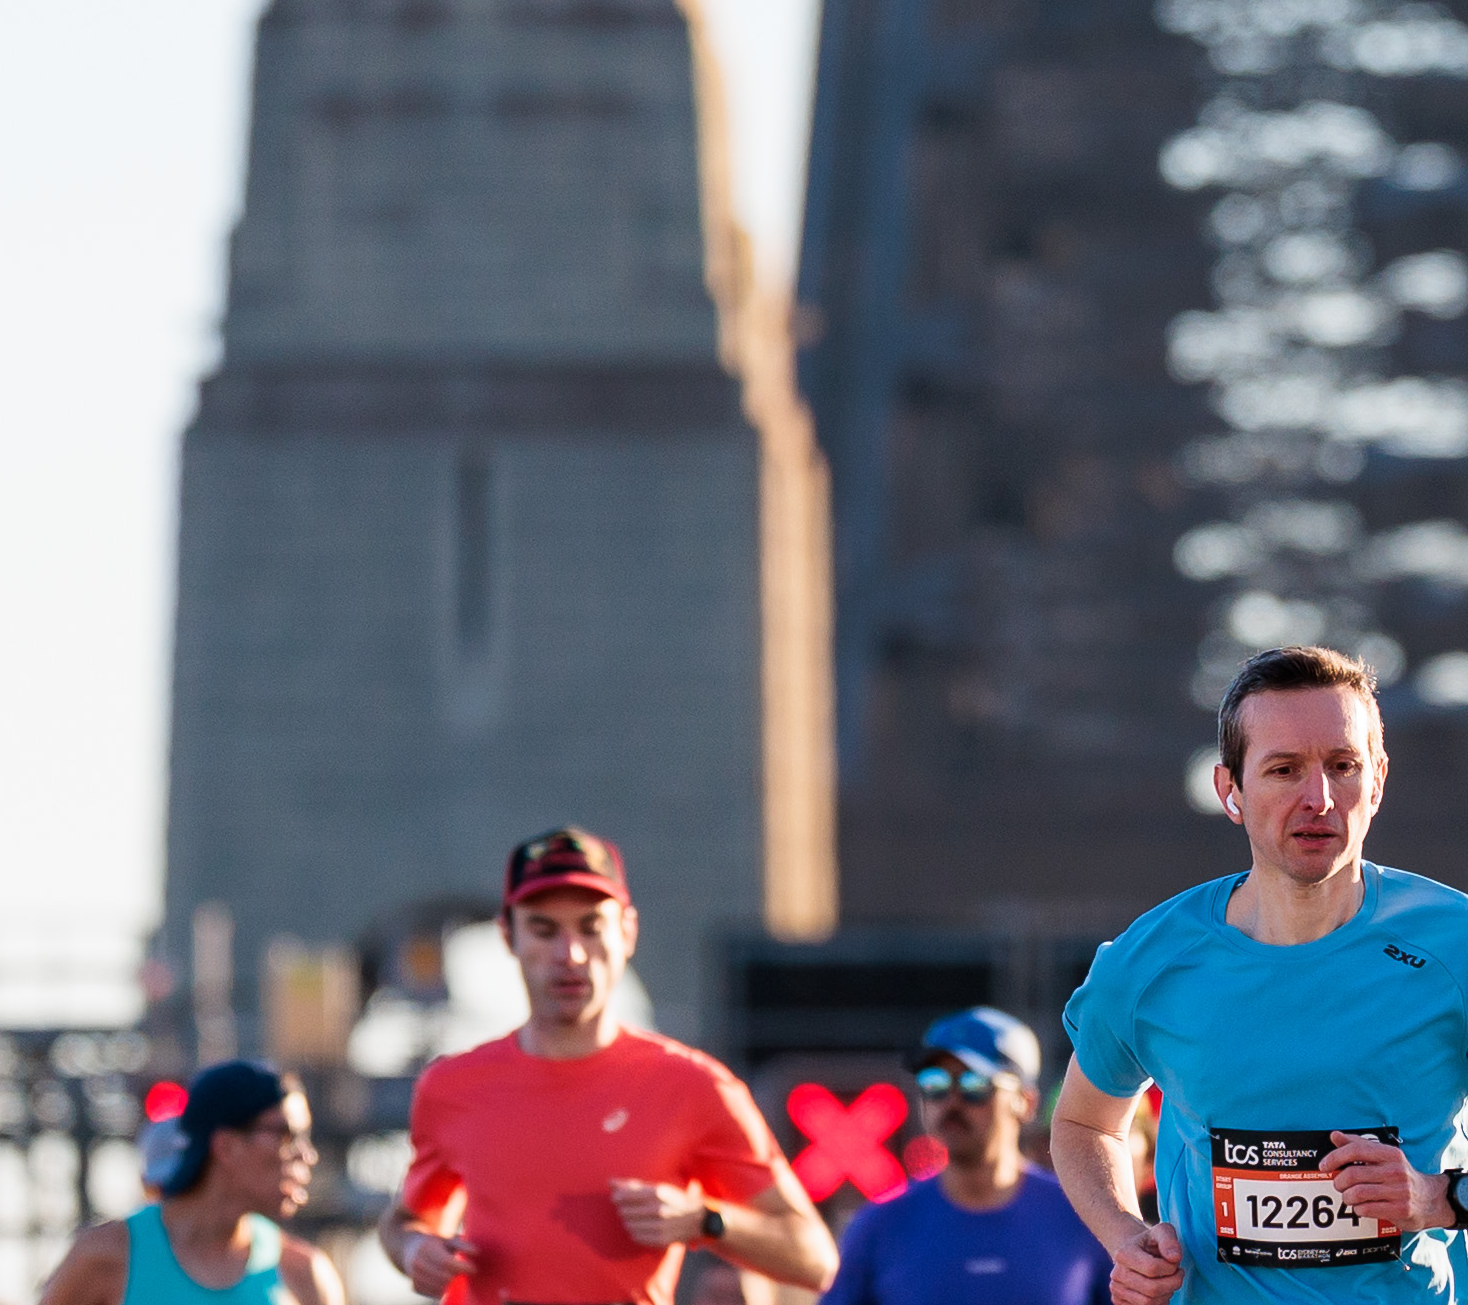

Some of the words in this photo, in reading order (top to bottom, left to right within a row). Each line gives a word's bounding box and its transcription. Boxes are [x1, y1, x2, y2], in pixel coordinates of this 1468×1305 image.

[1383, 944, 1426, 968] 2XU
[1225, 1139, 1259, 1165] tcs
[1262, 1141, 1286, 1149] TATA
[1262, 1150, 1318, 1158] CONSULTANCY
[1262, 1158, 1298, 1166] SERVICES
[1222, 1201, 1228, 1217] 1
[1246, 1195, 1361, 1229] 12264
[1278, 1247, 1296, 1260] tcs
